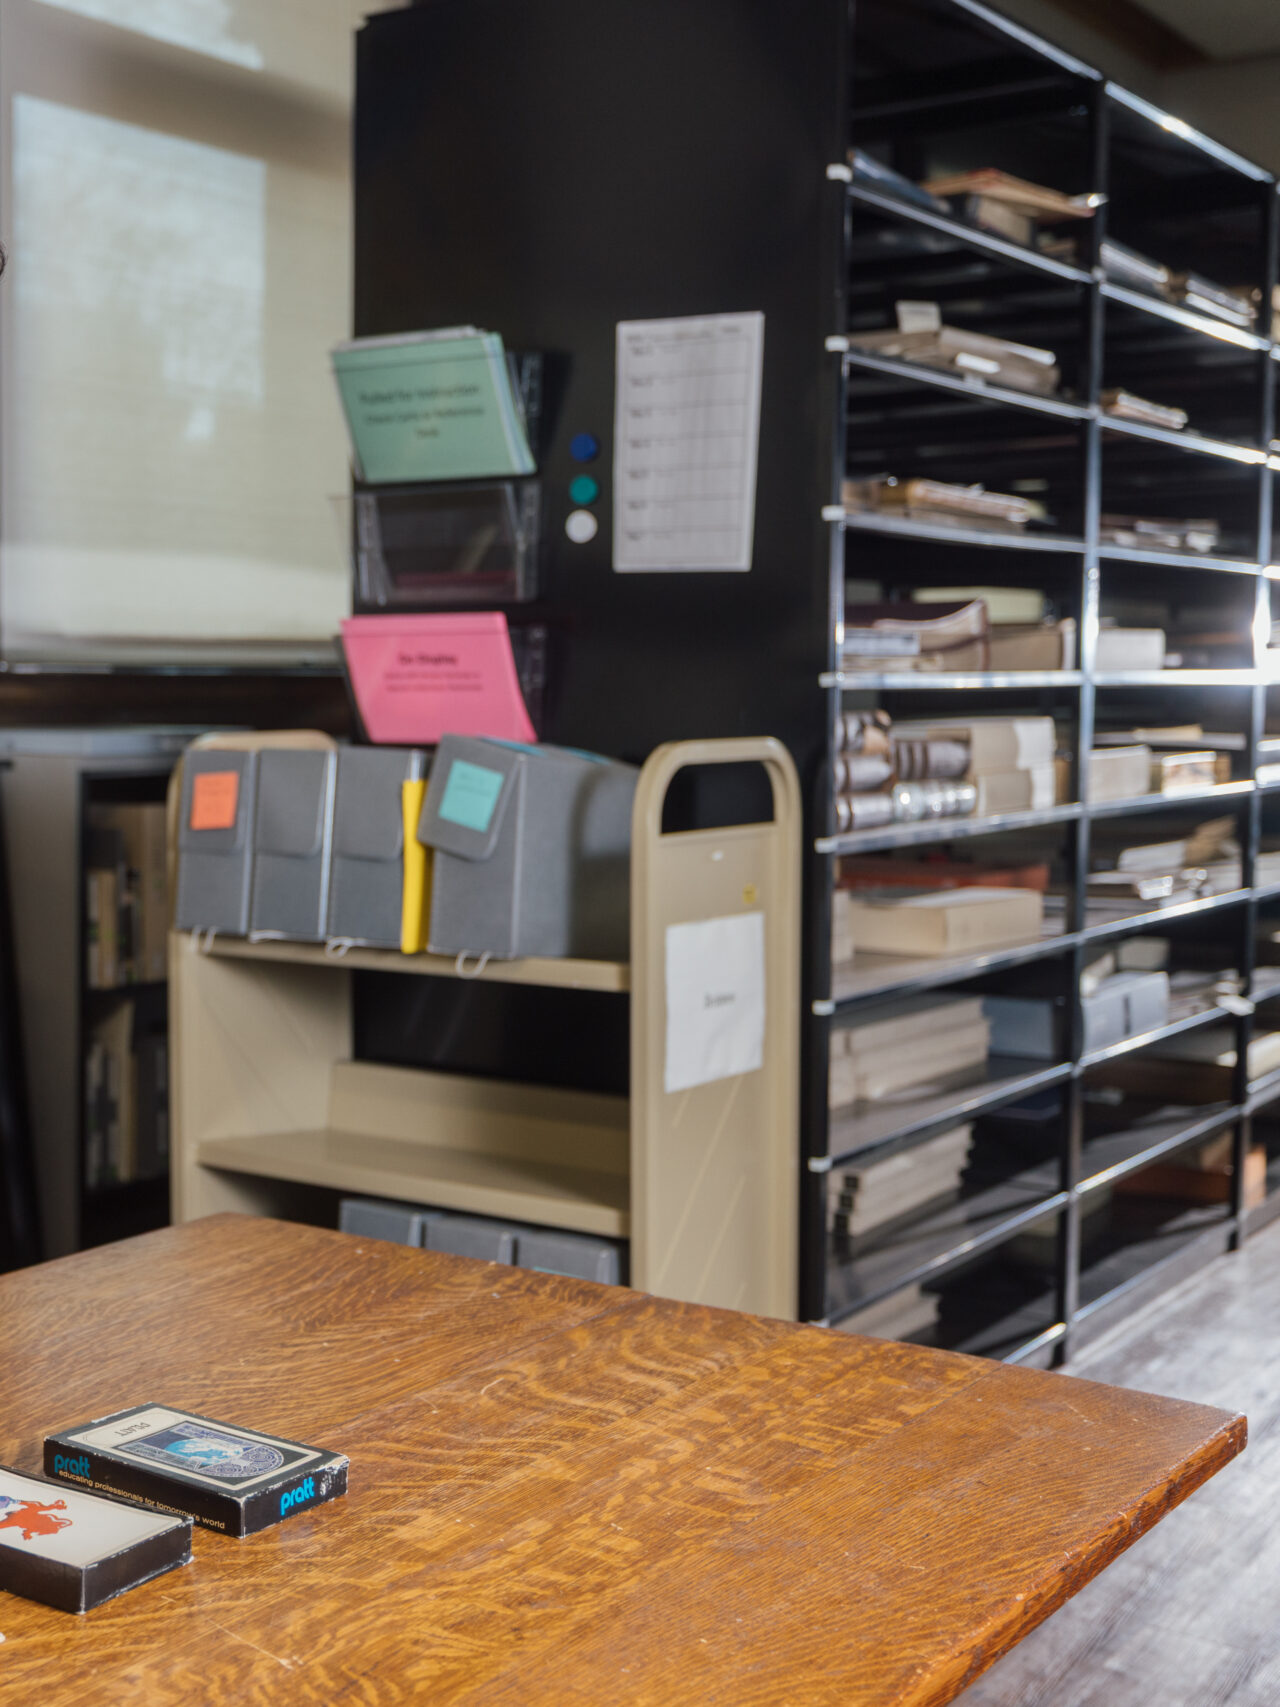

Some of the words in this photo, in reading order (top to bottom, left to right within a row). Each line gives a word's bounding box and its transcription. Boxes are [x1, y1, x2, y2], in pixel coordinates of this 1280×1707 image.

[54, 1454, 91, 1479] pratt
[58, 1469, 94, 1487] educating
[94, 1481, 144, 1504] professionals
[144, 1497, 156, 1506] for
[156, 1502, 200, 1522] tomorrow's
[202, 1517, 226, 1530] world
[280, 1476, 315, 1516] pratt
